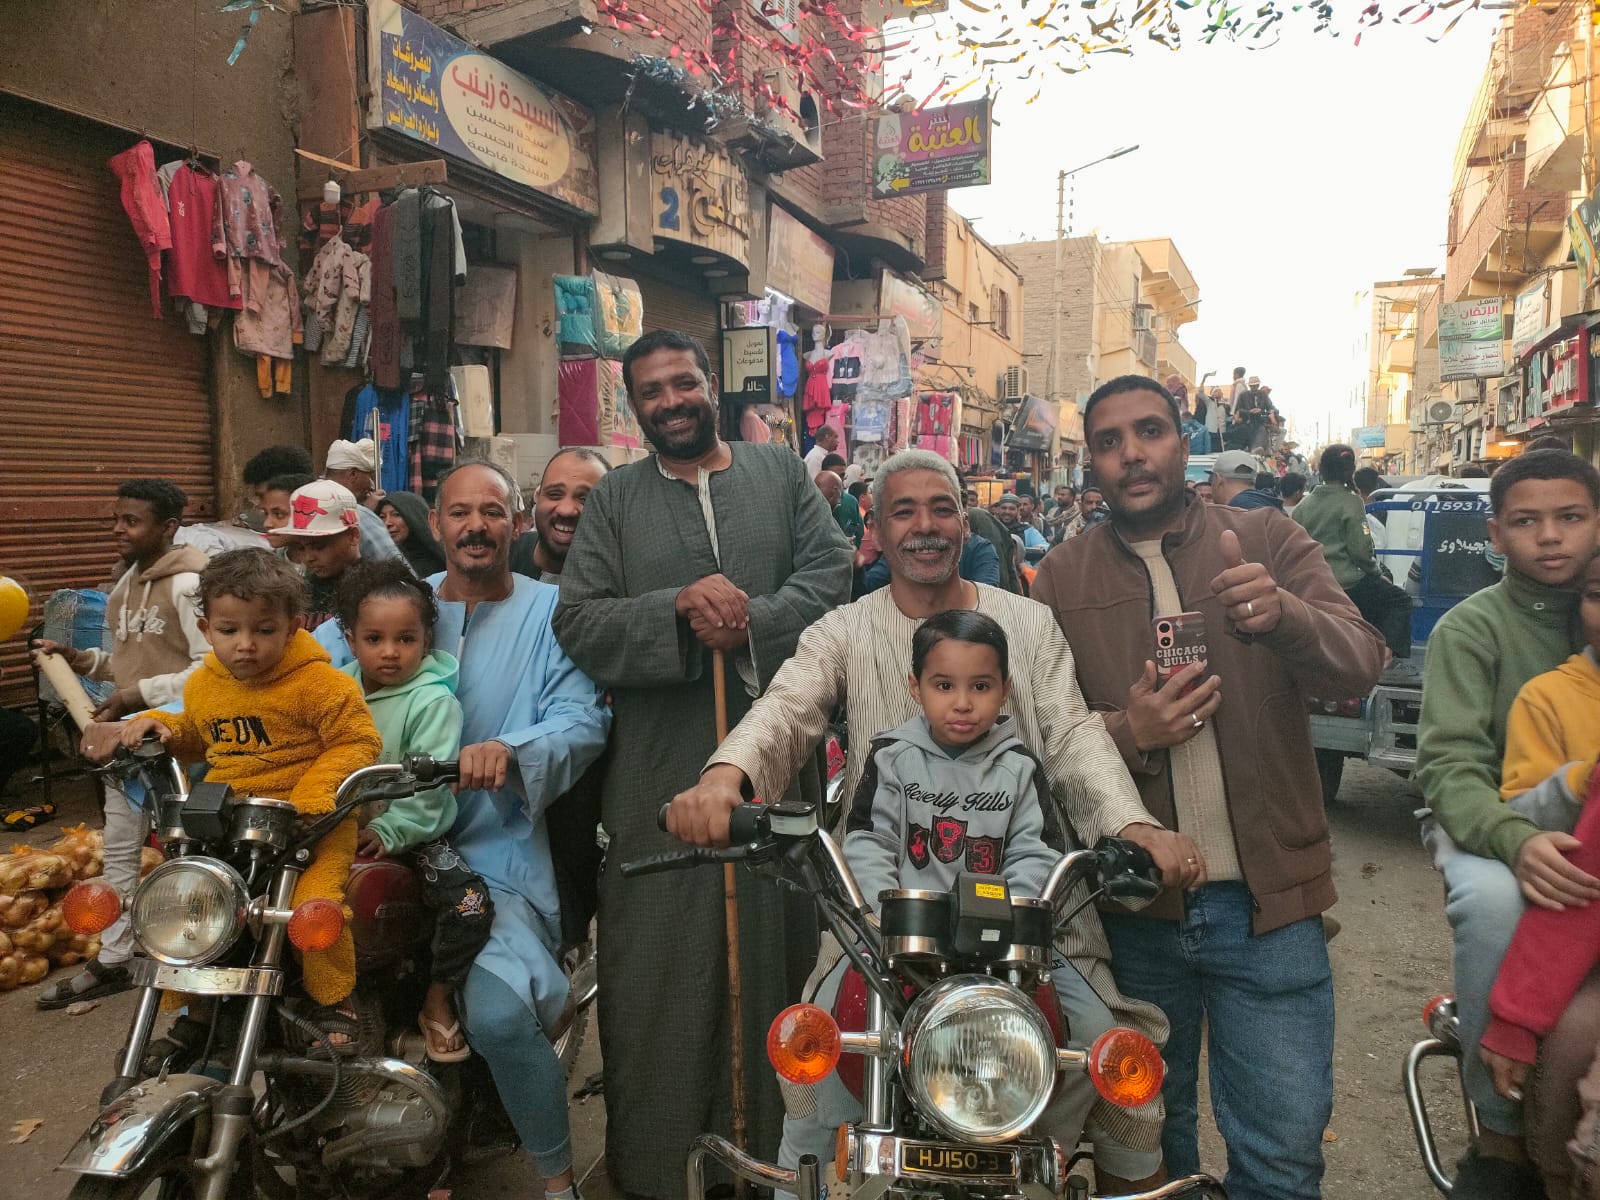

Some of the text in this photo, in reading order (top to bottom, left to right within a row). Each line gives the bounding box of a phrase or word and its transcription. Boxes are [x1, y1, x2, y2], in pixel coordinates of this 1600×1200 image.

[452, 65, 560, 137] السيدة زينب
[466, 105, 514, 134] الحسين
[467, 123, 514, 150] الحسن
[467, 137, 508, 163] فاطمة
[908, 114, 982, 158] العتبة
[659, 186, 680, 232] 2
[1156, 645, 1207, 659] CHICAGO
[1163, 655, 1199, 667] BULLS
[903, 782, 1014, 815] Beverly Hills
[973, 841, 995, 874] 3
